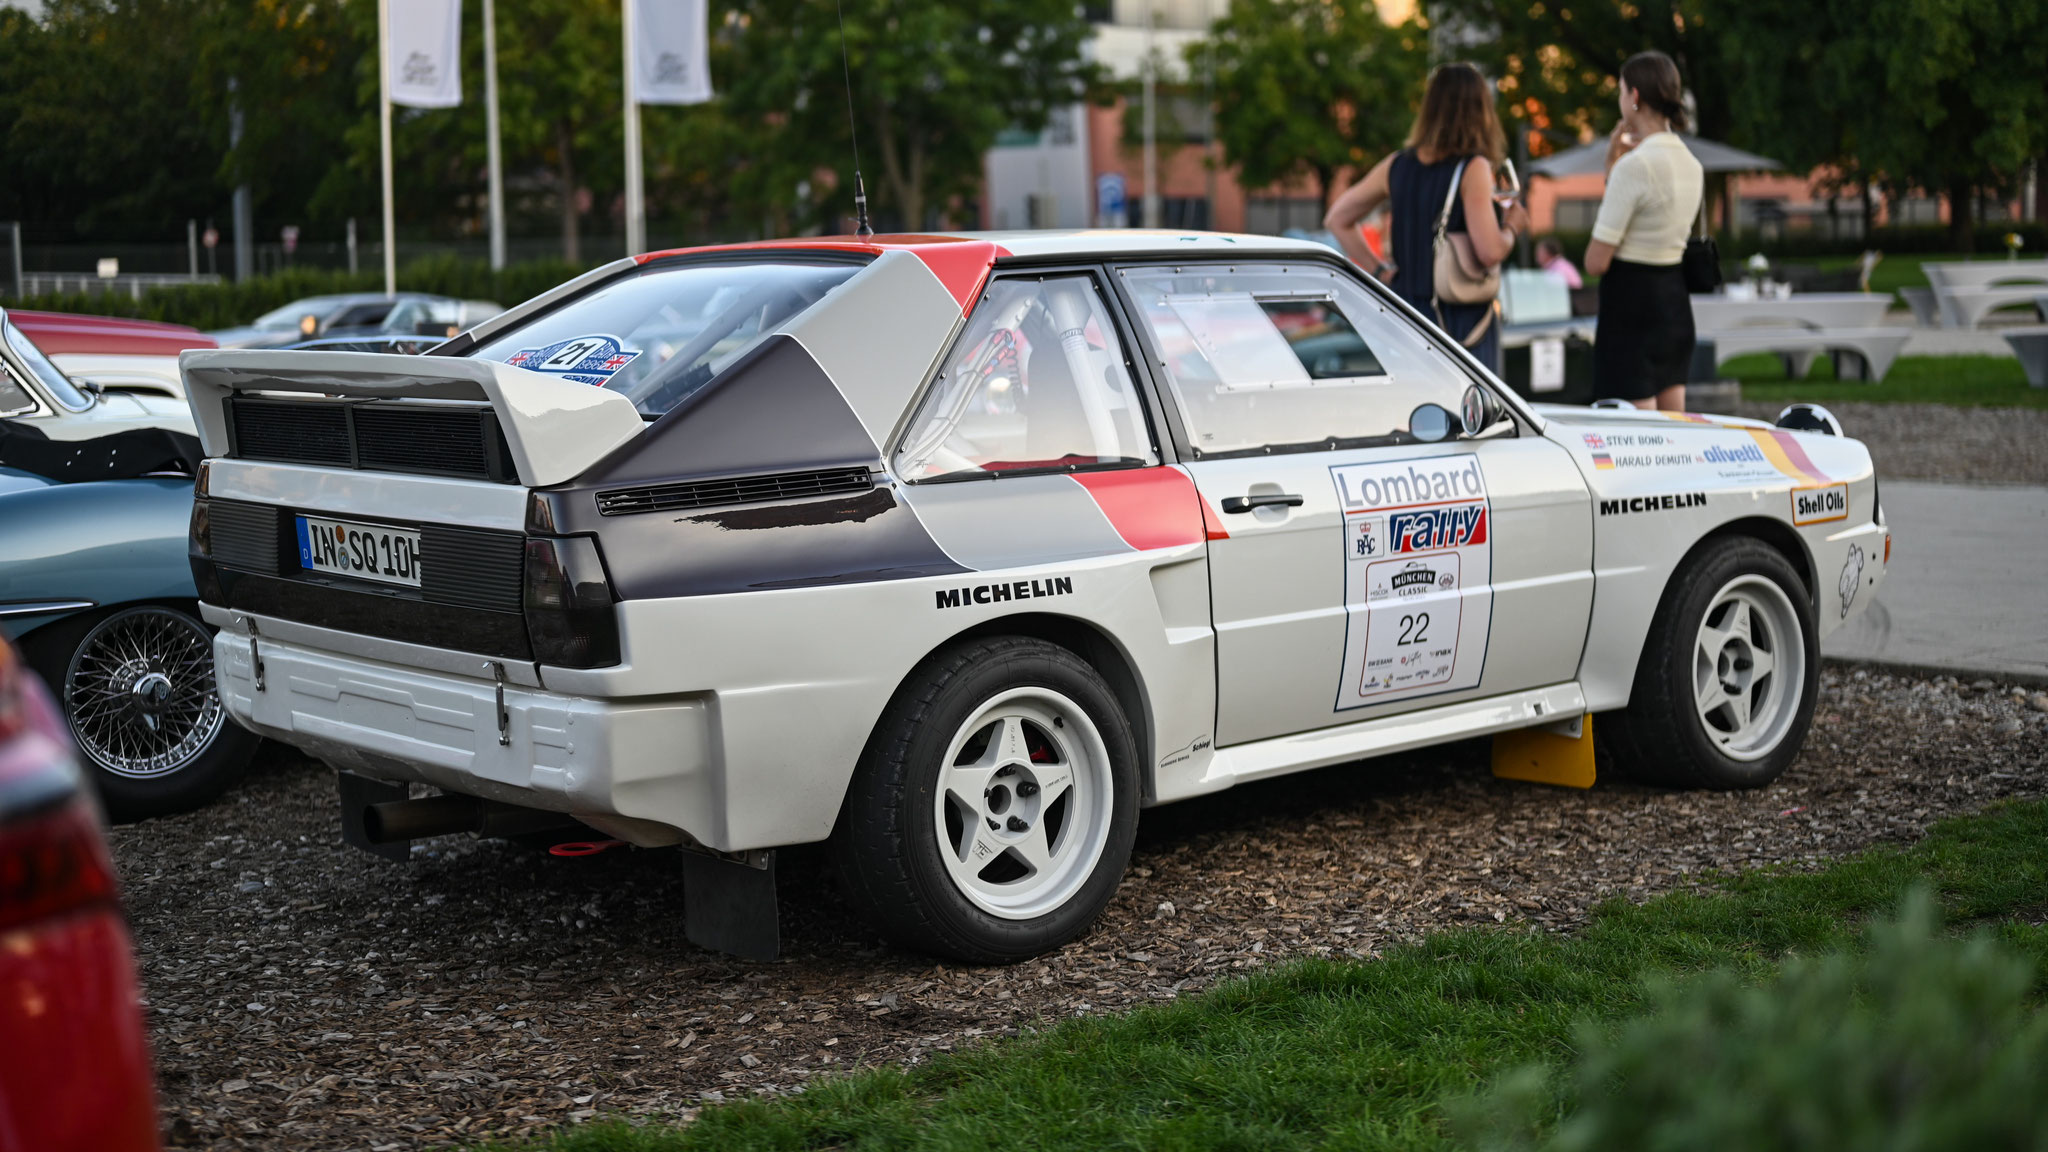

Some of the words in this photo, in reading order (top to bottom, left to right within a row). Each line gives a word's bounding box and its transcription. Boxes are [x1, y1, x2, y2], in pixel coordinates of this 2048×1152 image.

[547, 342, 598, 366] 21
[1606, 435, 1635, 447] STEVE
[1638, 435, 1664, 446] BOND
[1615, 456, 1652, 468] HARALD
[1655, 454, 1692, 466] DEMUTH
[1703, 444, 1764, 464] olivetti
[1337, 460, 1482, 508] Lombard
[1600, 492, 1707, 516] MICHELIN
[1798, 493, 1824, 515] Shell
[1826, 491, 1844, 512] Oils
[1392, 506, 1484, 552] rally
[311, 524, 337, 568] IN
[349, 530, 379, 574] SQ
[381, 534, 421, 579] 10H
[1356, 534, 1376, 555] RAC
[1394, 571, 1434, 587] MÜNCHEN
[935, 576, 1073, 609] MICHELIN
[1399, 586, 1428, 597] CLASSIC
[1397, 612, 1430, 647] 22
